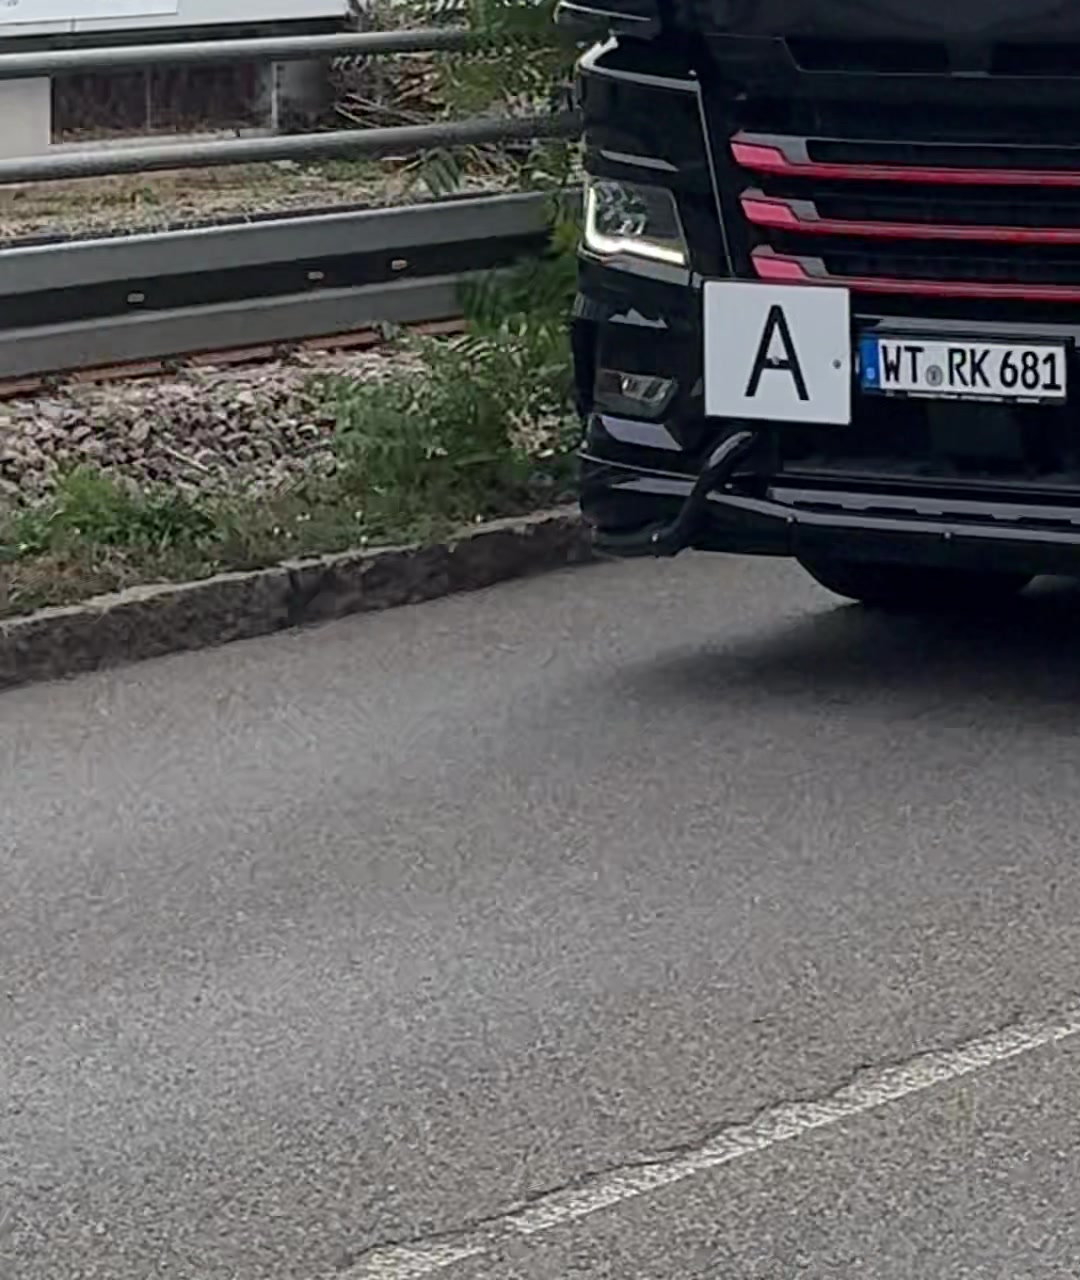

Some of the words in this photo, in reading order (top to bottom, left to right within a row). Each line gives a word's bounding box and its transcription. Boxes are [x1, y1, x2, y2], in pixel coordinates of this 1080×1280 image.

[744, 303, 810, 402] A
[881, 344, 925, 384] WT
[948, 347, 991, 388] RK
[999, 350, 1063, 391] 681
